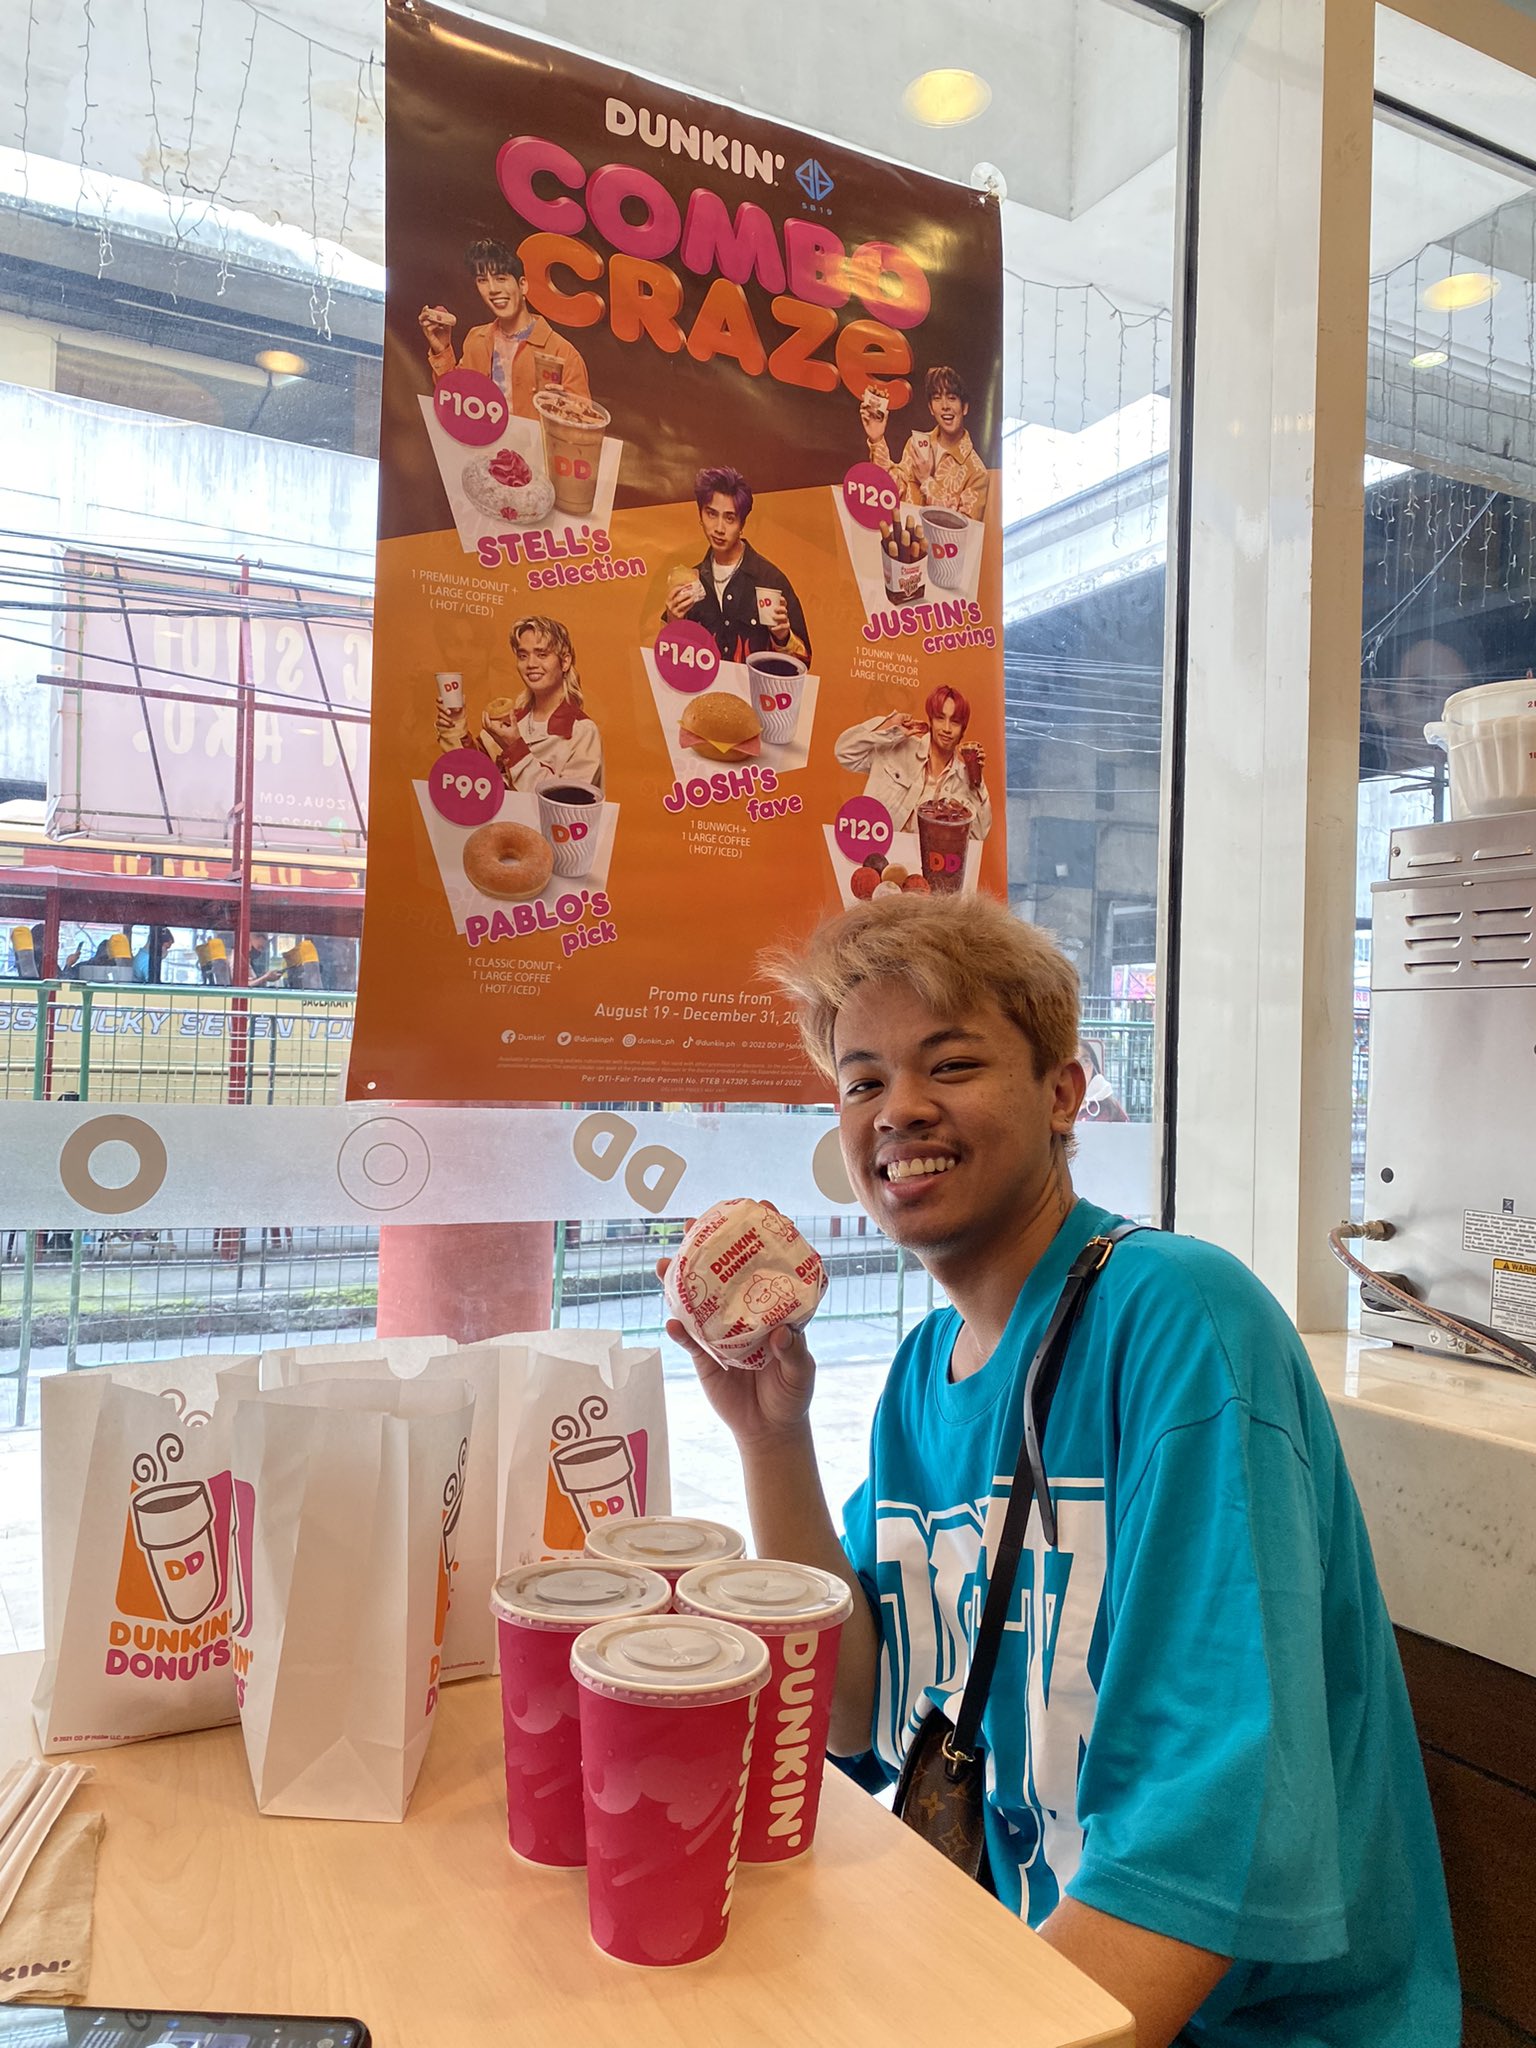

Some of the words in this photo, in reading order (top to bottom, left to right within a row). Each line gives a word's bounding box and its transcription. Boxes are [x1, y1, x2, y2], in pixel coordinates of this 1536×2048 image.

[605, 97, 785, 187] DUNKIN'
[801, 201, 833, 216] SB19
[496, 135, 931, 329] COMBO
[553, 455, 592, 480] DD
[931, 543, 958, 558] DD
[419, 570, 469, 587] PREMIUM
[472, 578, 510, 593] DONUT
[526, 555, 646, 590] selection
[429, 585, 463, 600] LARGE
[465, 590, 504, 606] COFFEE
[758, 598, 772, 608] DD
[922, 624, 997, 655] craving
[861, 647, 894, 660] DUNKIN'
[896, 653, 912, 664] YAN
[858, 658, 875, 669] HOT
[876, 661, 906, 674] CHOCO
[906, 666, 919, 676] OR
[444, 681, 459, 692] DD
[850, 668, 876, 681] LARGE
[877, 673, 890, 683] ICY
[890, 675, 920, 688] CHOCO
[759, 693, 792, 712] DD
[747, 795, 802, 822] fave
[552, 822, 588, 846] DD
[697, 820, 740, 834] BUNWICH
[688, 833, 717, 843] LARGE
[719, 835, 751, 847] COFFEE
[929, 852, 961, 873] DD
[561, 920, 617, 958] pick
[474, 957, 516, 970] CLASSIC
[517, 960, 555, 971] DONUT
[480, 971, 513, 982] LARGE
[514, 972, 551, 984] COFFEE
[649, 986, 698, 1002] Promo
[702, 992, 735, 1004] runs
[739, 991, 772, 1006] from
[594, 1002, 648, 1021] August
[653, 1005, 670, 1019] 19
[683, 1006, 756, 1023] December
[759, 1010, 779, 1026] 31,
[749, 1040, 766, 1049] 2022
[581, 1074, 596, 1083] Per
[632, 1076, 656, 1085] Trade
[657, 1076, 684, 1085] Permit
[685, 1078, 698, 1086] No.
[751, 1080, 774, 1088] Series
[710, 1227, 760, 1275] DUNKIN'
[718, 1239, 764, 1284] BUNWICH
[761, 1304, 785, 1325] HAM
[769, 1298, 801, 1326] CHEESE
[590, 1496, 624, 1517] DD
[164, 1550, 205, 1581] DD
[109, 1609, 232, 1654] DUNKIN'
[105, 1638, 231, 1681] DONUTS
[768, 1631, 819, 1848] DUNKIN'
